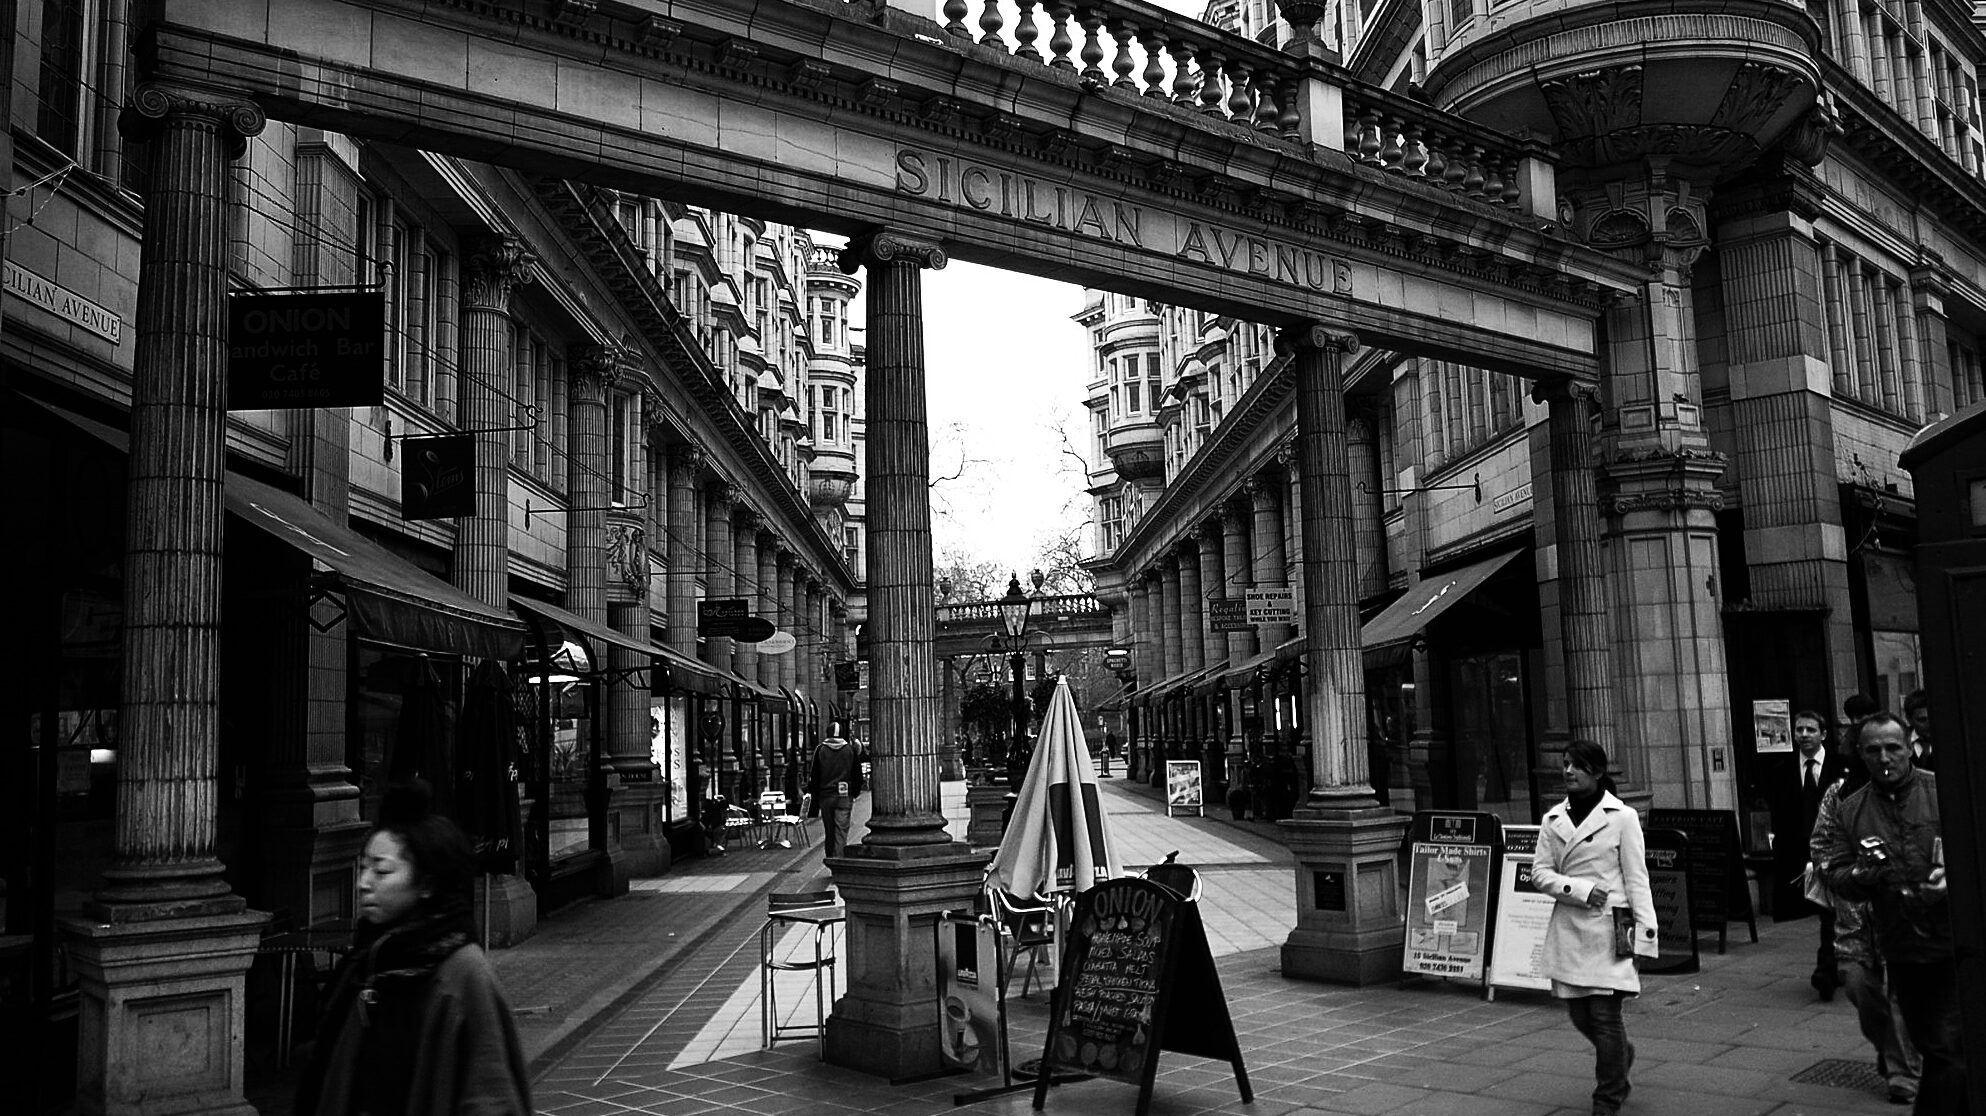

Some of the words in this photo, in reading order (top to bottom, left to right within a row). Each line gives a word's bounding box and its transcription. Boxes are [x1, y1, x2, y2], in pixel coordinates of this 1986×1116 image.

[896, 149, 1144, 248] SICILIAN
[1176, 221, 1354, 299] AVENUE
[62, 297, 118, 338] AVENUE
[243, 307, 351, 334] ONION
[336, 337, 376, 357] Bar
[269, 362, 321, 381] Café
[1247, 593, 1263, 601] SHOE
[1265, 593, 1292, 601] REPAIRS
[1263, 608, 1291, 617] CUTTING
[1712, 749, 1724, 771] H
[1415, 845, 1439, 855] Tailor
[1440, 845, 1463, 856] Made
[1463, 846, 1487, 857] Shirts
[1094, 886, 1165, 925] ONION
[1135, 931, 1161, 949] SOUP
[1088, 946, 1113, 959] MIXED
[1117, 946, 1156, 964] SALADS
[1422, 952, 1447, 961] Sicilian
[1448, 955, 1472, 963] Avenue
[1124, 963, 1150, 975] MELT
